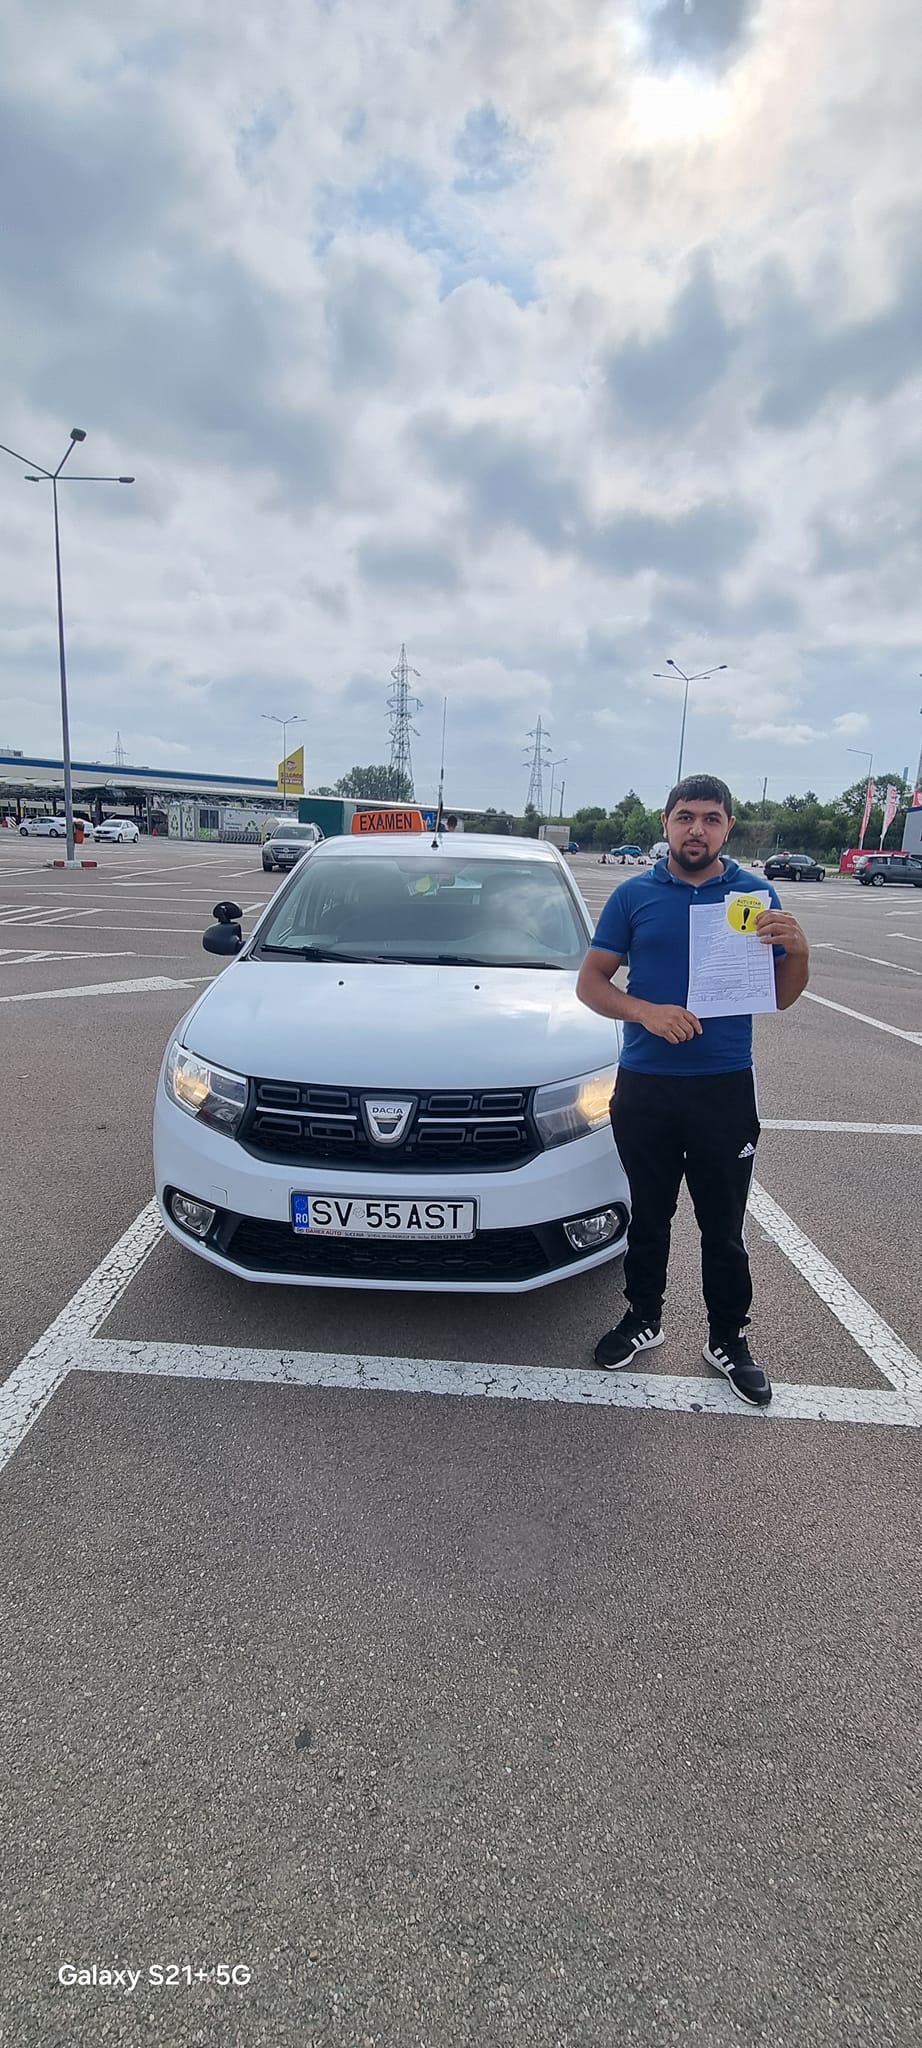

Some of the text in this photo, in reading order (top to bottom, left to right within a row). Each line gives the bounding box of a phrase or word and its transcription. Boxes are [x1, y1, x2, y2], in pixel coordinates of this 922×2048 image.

[360, 813, 412, 831] EXAMEN
[295, 1213, 308, 1224] RO
[312, 1200, 463, 1230] SV 55 AST
